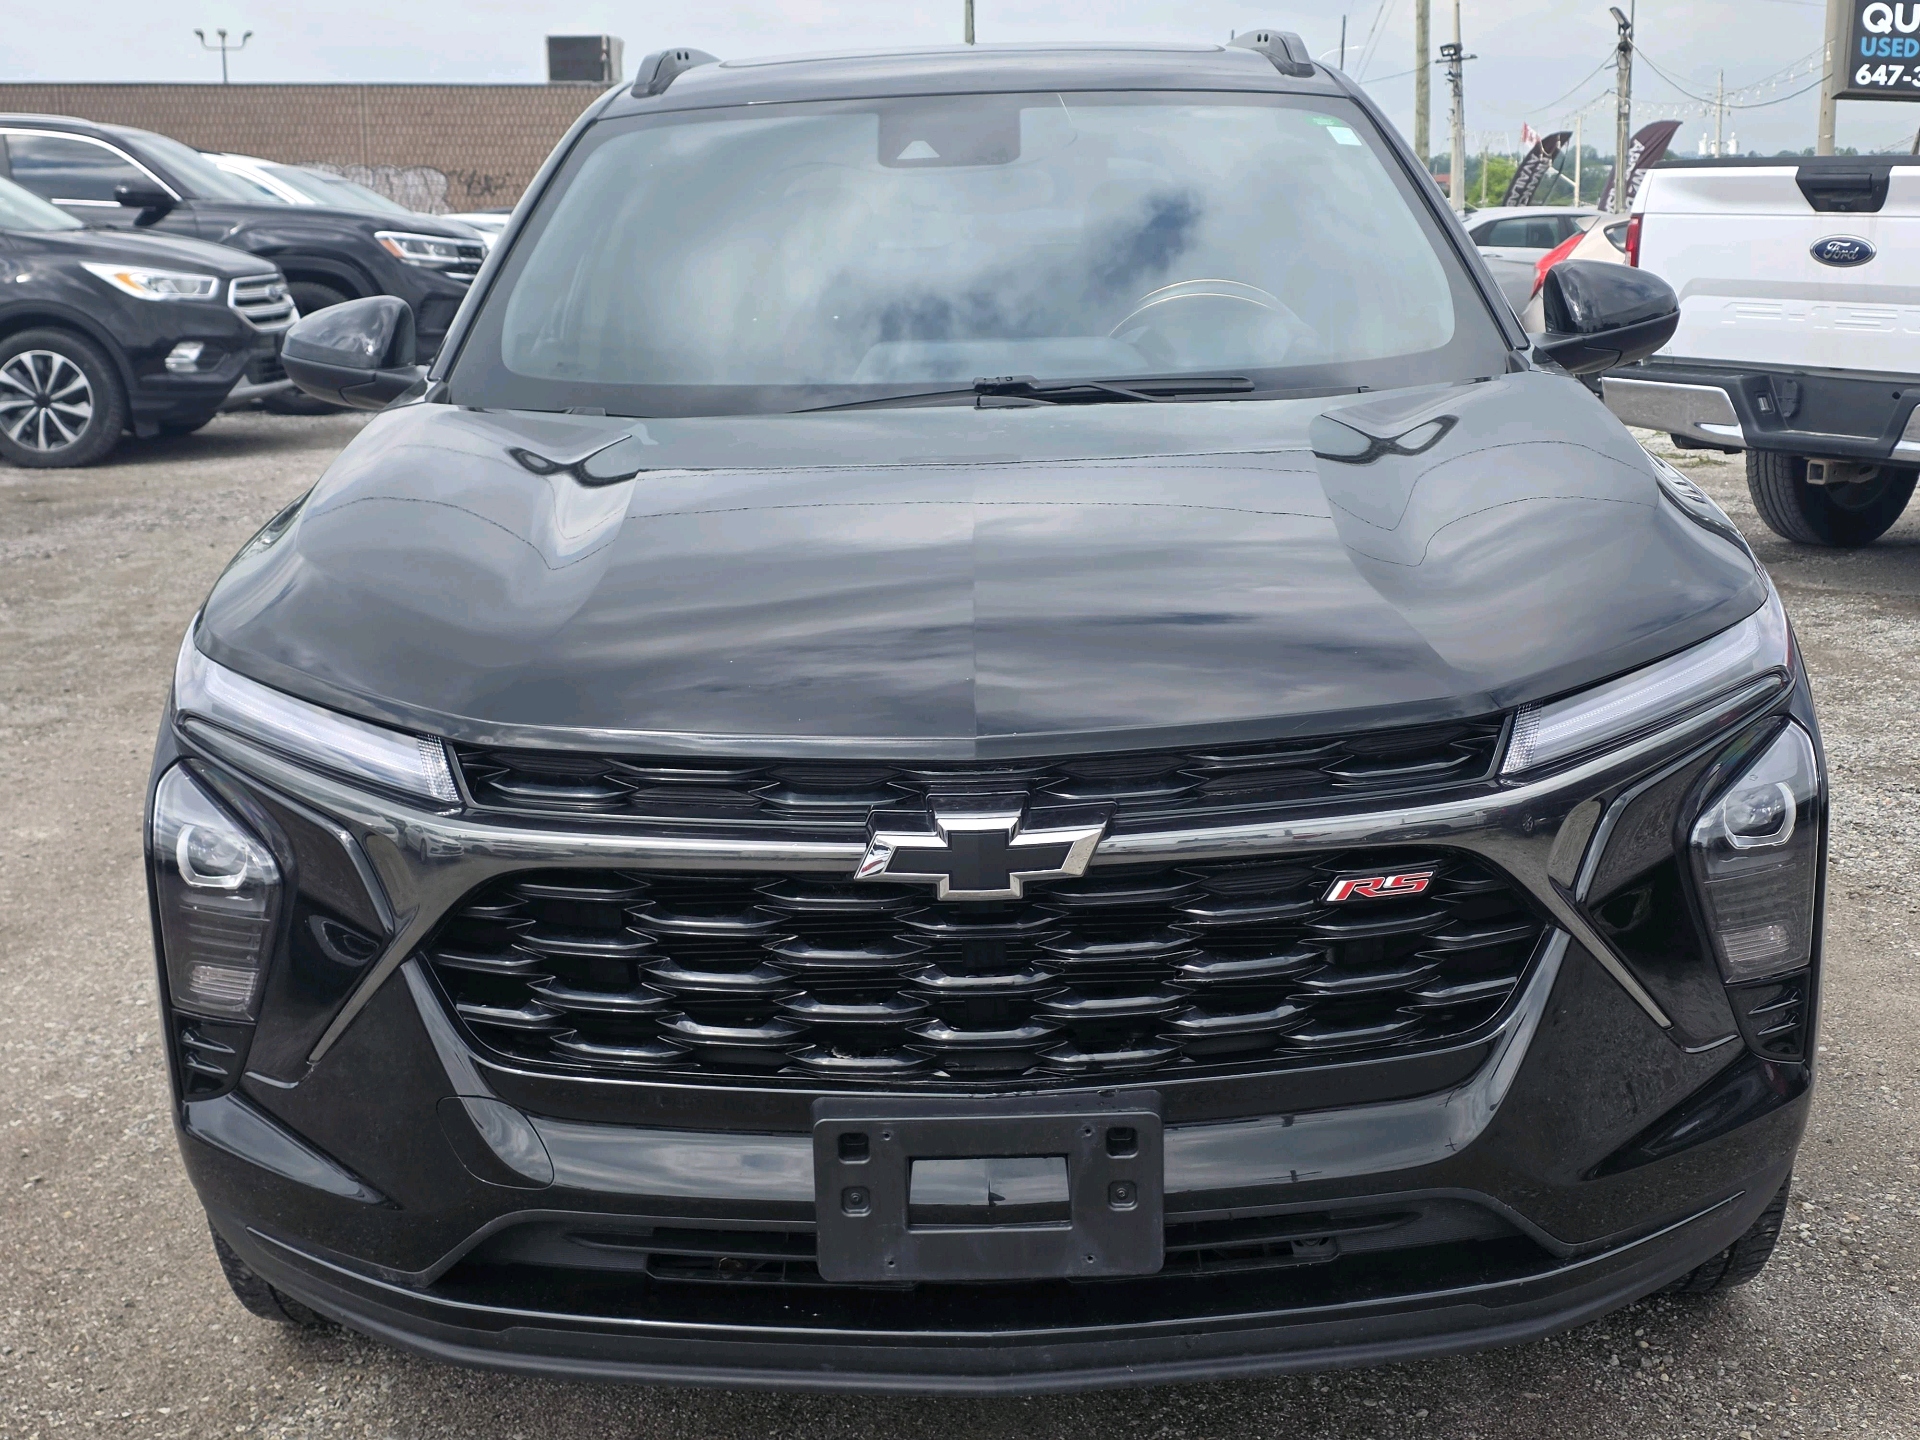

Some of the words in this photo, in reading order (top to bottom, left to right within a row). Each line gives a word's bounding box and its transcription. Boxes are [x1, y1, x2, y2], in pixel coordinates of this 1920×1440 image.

[1861, 36, 1920, 58] USED
[1517, 157, 1552, 207] FINANC
[1823, 241, 1860, 260] Ford
[1326, 871, 1434, 902] RS
